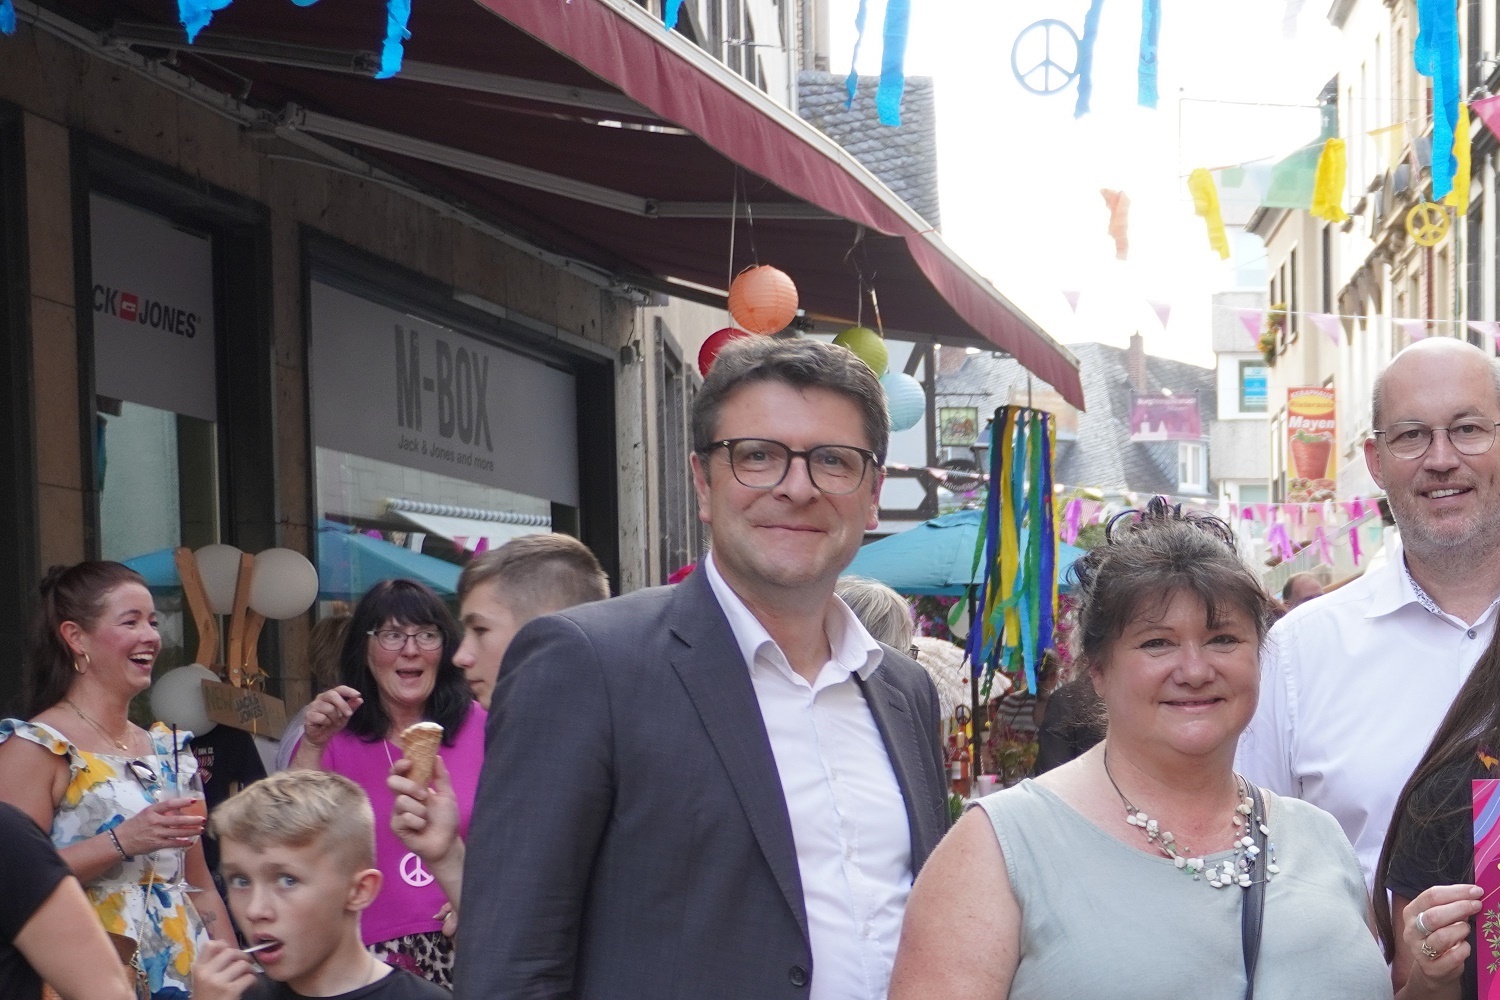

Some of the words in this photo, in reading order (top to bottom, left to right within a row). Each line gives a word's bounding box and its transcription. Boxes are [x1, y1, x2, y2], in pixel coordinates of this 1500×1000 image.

[138, 299, 196, 339] JONES
[395, 324, 494, 452] M-BOX
[1289, 415, 1335, 431] Mayen
[398, 434, 419, 453] Jack
[421, 440, 428, 456] &
[430, 442, 455, 463] Jones
[456, 451, 474, 467] and
[473, 455, 494, 472] more
